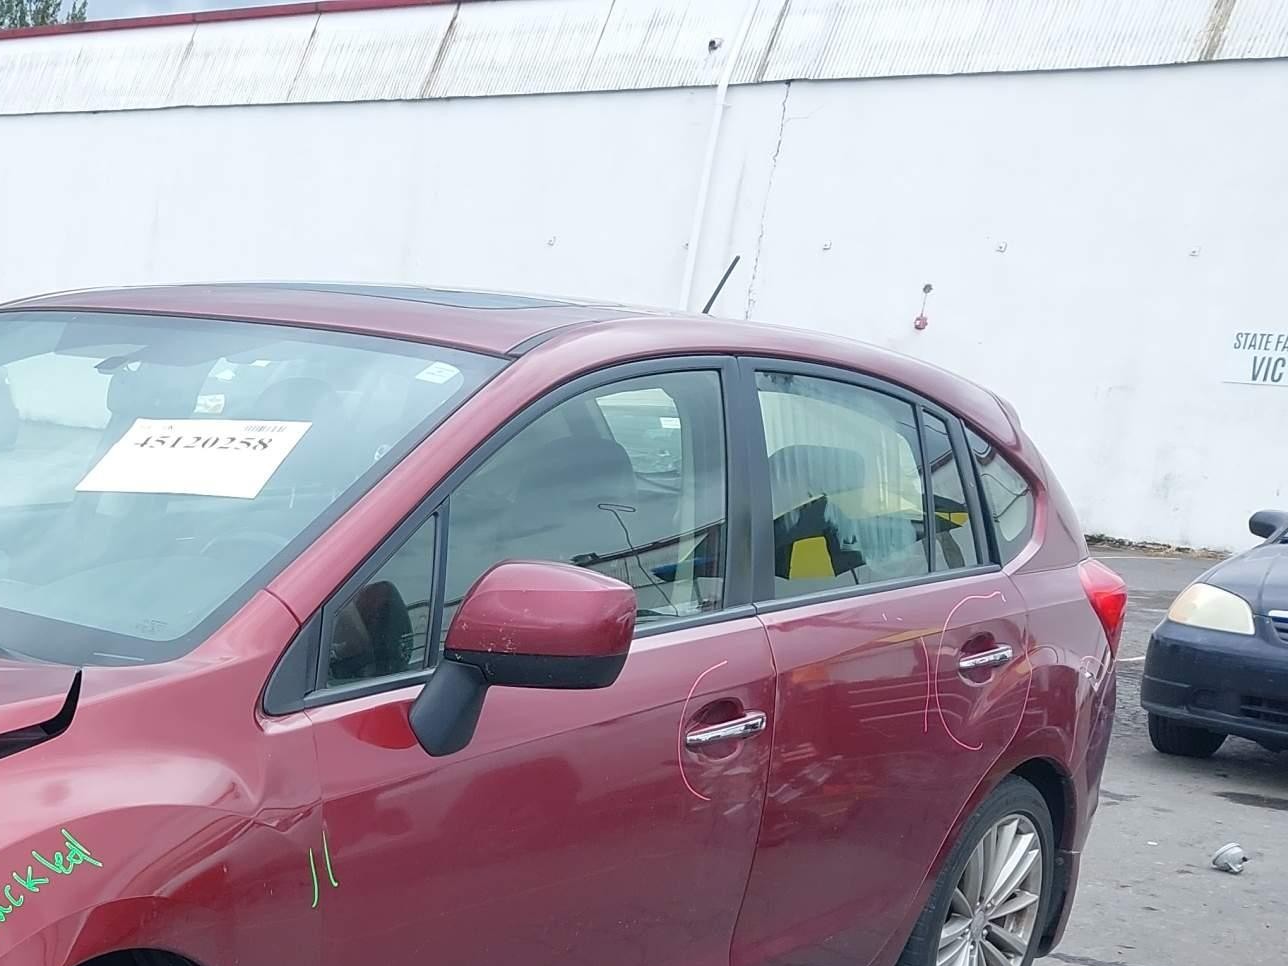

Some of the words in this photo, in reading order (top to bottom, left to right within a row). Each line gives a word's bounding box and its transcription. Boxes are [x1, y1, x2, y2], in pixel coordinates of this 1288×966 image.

[1233, 332, 1274, 351] STATE
[1251, 355, 1287, 383] VIC
[133, 435, 274, 451] 45120258
